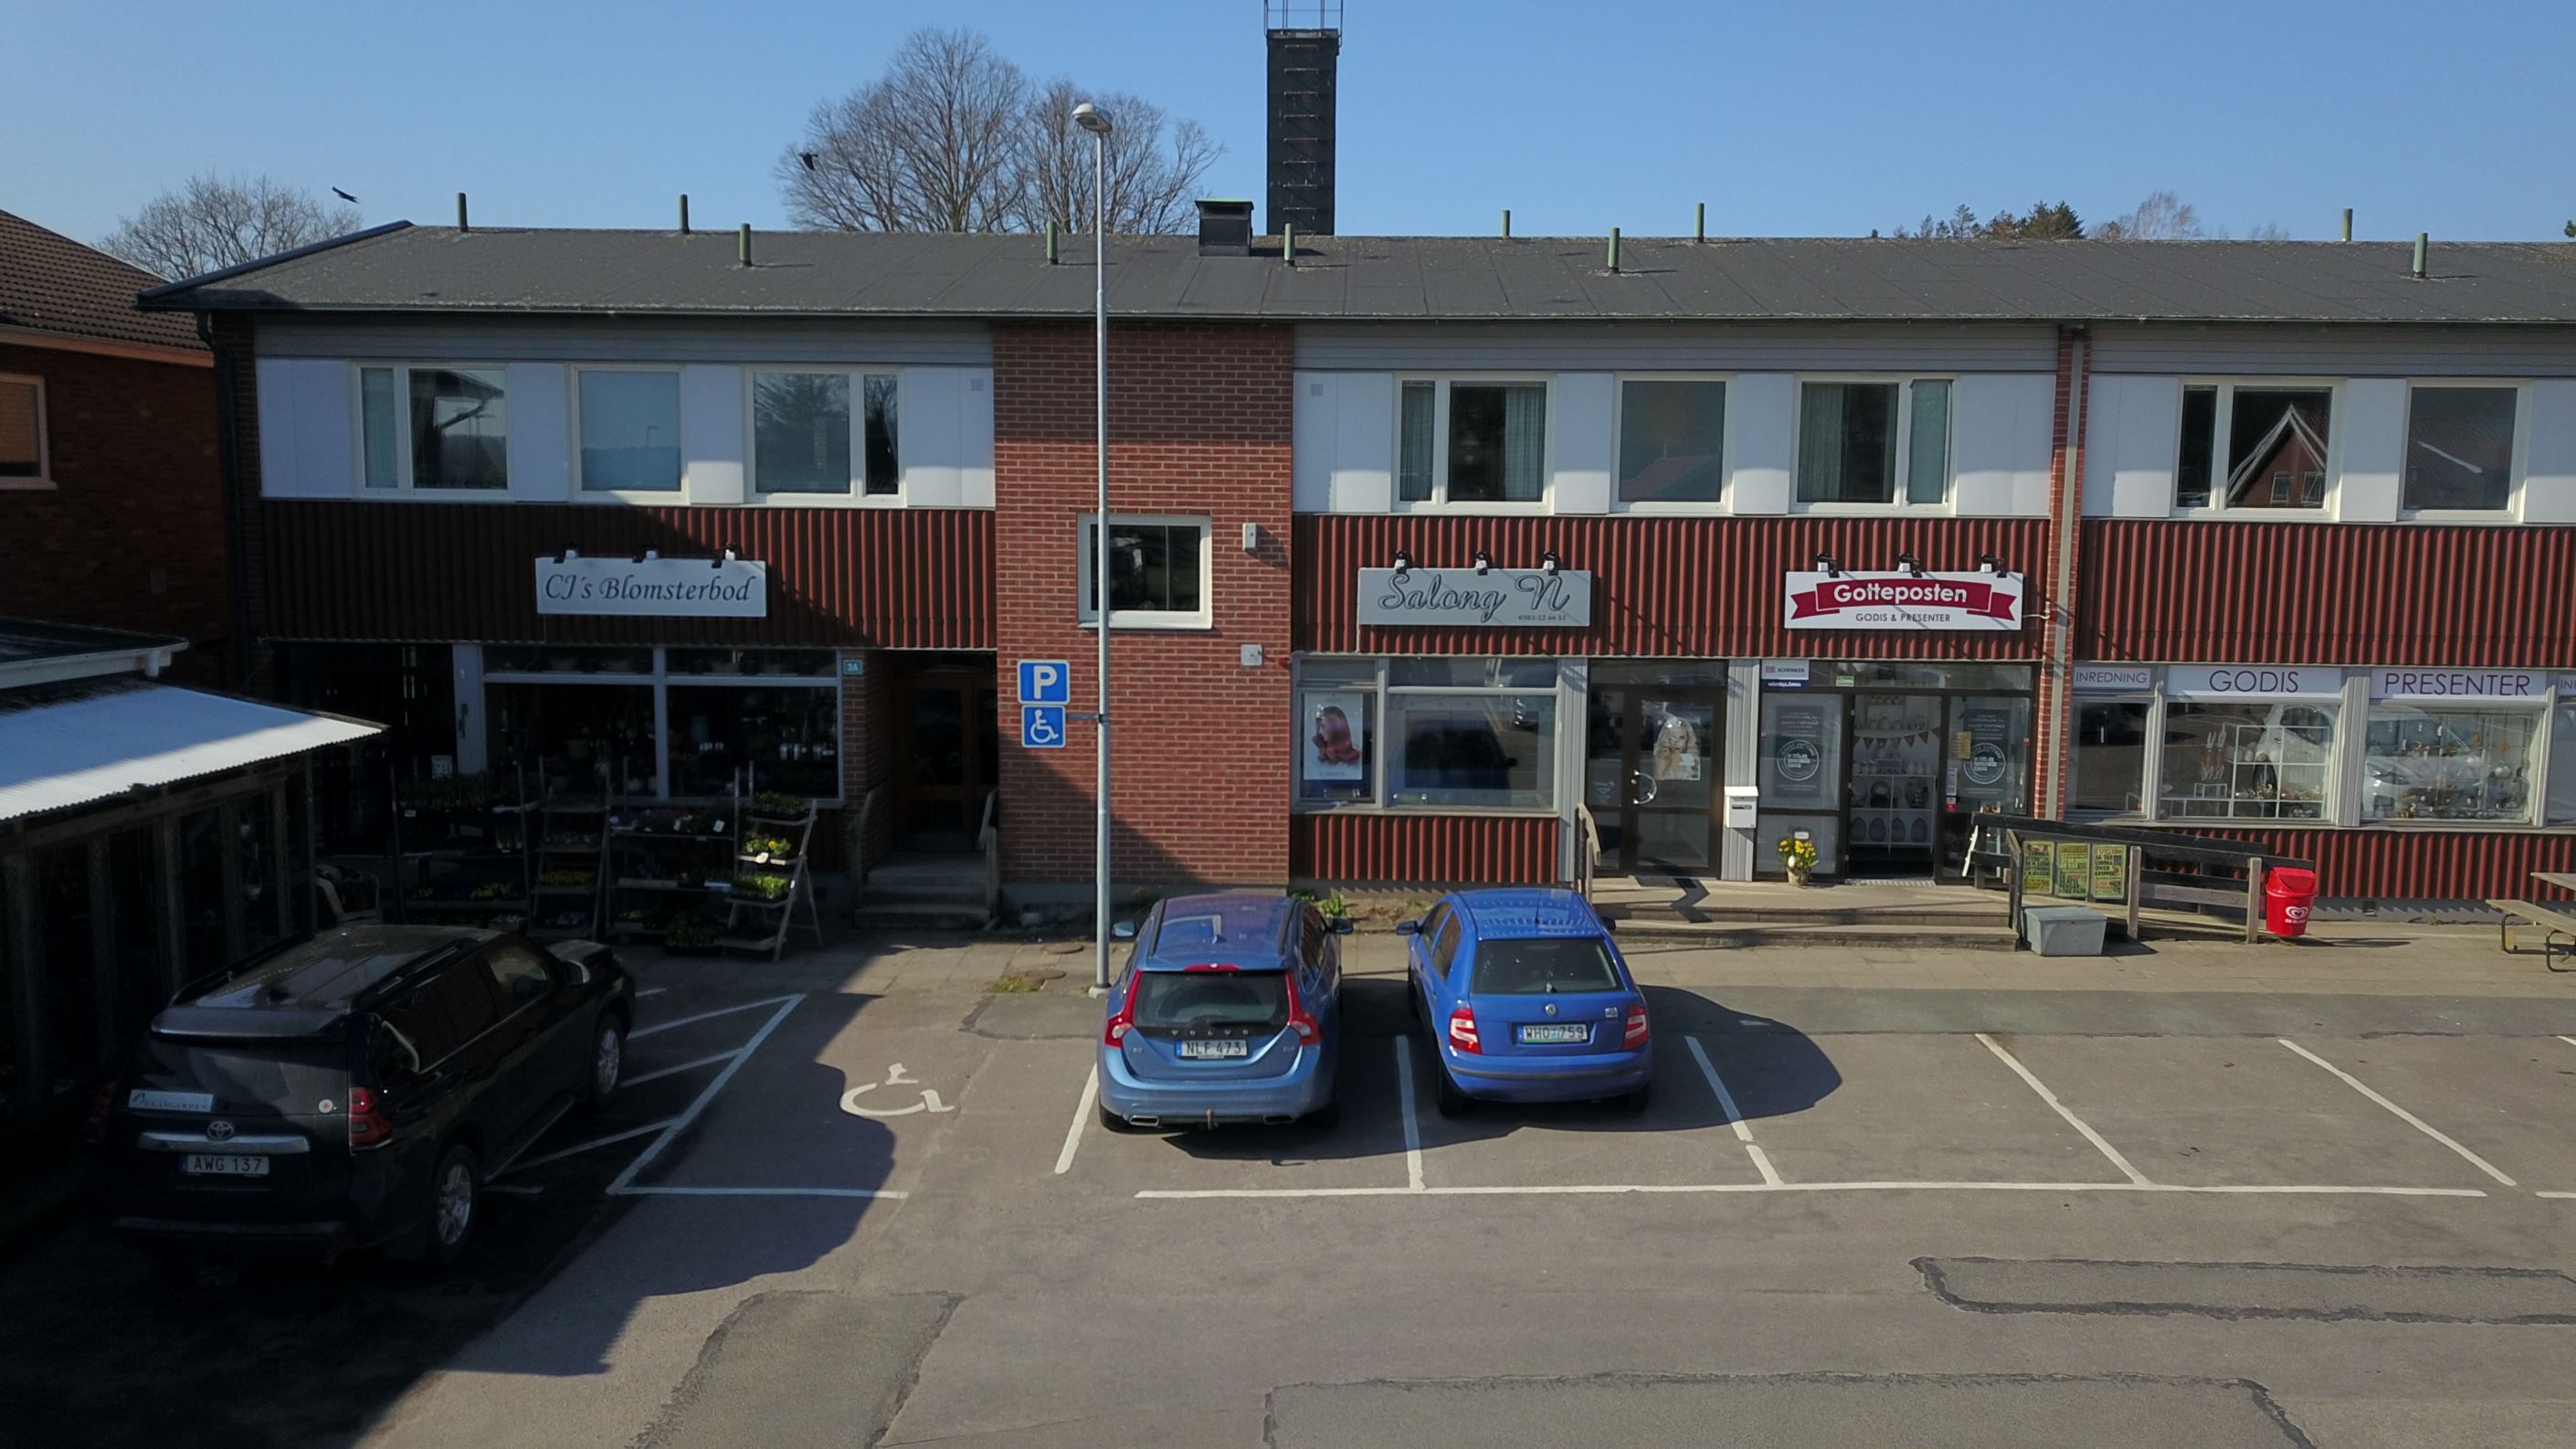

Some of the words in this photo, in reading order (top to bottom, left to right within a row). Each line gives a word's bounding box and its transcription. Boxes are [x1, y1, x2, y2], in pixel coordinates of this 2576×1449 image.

[598, 574, 757, 602] Blomsterbod
[1833, 582, 1968, 604] Gotteposten
[1378, 572, 1508, 623] Salong
[1514, 574, 1571, 612] N
[1855, 613, 1889, 622] GODIS
[1890, 613, 1897, 622] &
[1900, 613, 1951, 623] PRESENTER
[1033, 665, 1058, 699] P
[2075, 672, 2148, 683] INREDNING
[2209, 670, 2299, 693] GODIS
[2384, 672, 2531, 696] PRESENTER
[1171, 1028, 1250, 1037] VOLVO
[1526, 1025, 1550, 1039] WHO
[1558, 1025, 1585, 1039] 759
[1187, 1042, 1211, 1055] NLF
[1216, 1041, 1241, 1054] 473
[194, 1157, 225, 1172] AWG
[232, 1158, 261, 1172] 137
